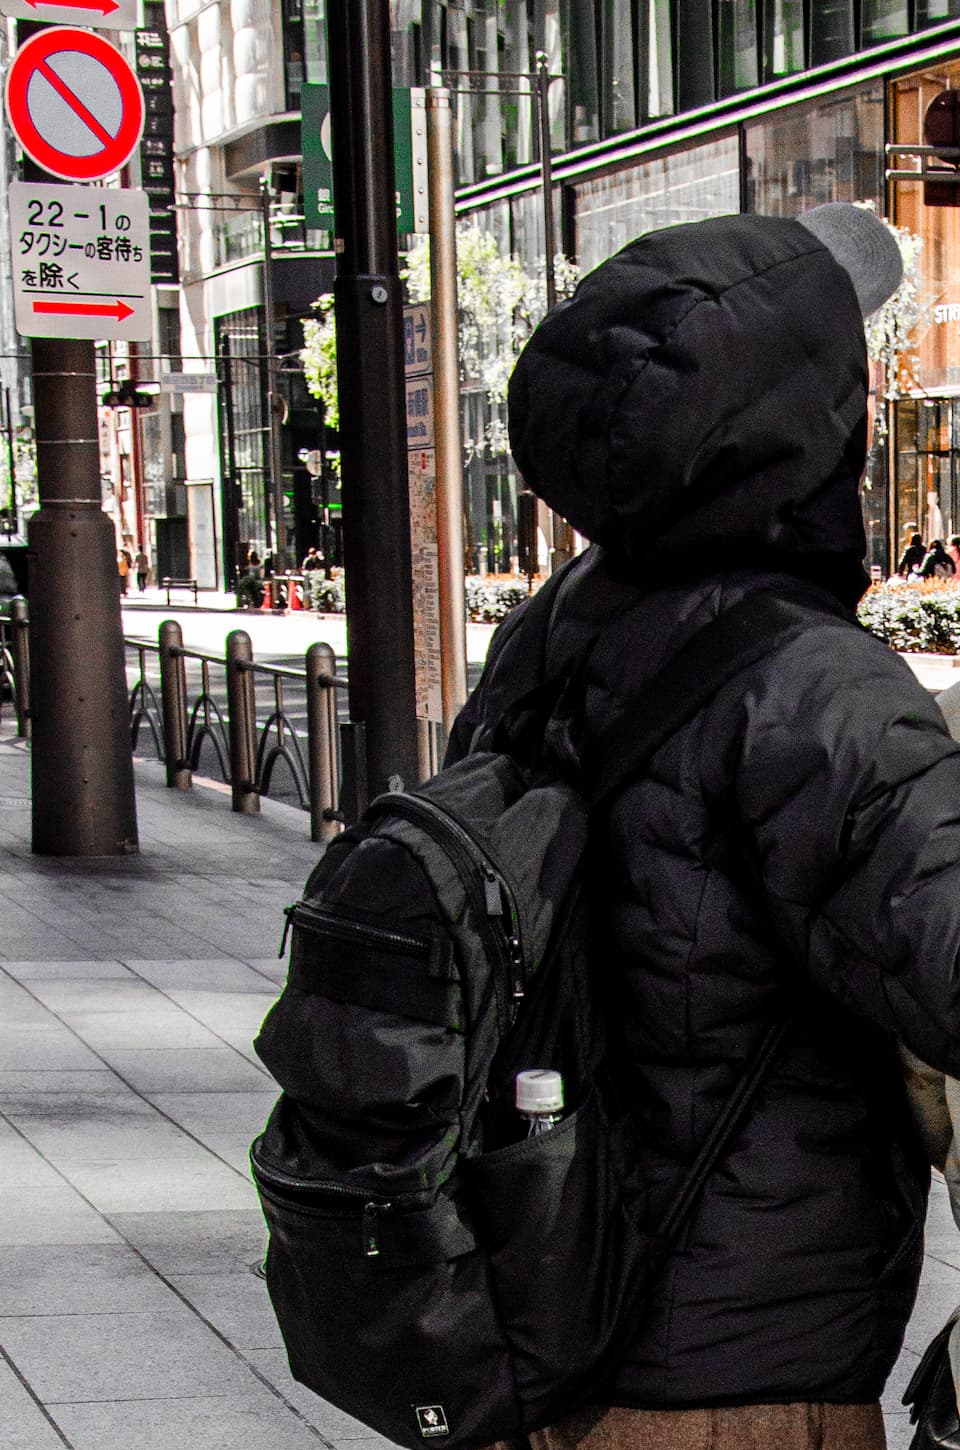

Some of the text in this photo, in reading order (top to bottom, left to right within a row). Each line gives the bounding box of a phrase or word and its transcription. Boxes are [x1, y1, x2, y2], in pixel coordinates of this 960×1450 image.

[19, 231, 143, 262] タクシーの客待ち
[21, 262, 80, 290] を除く
